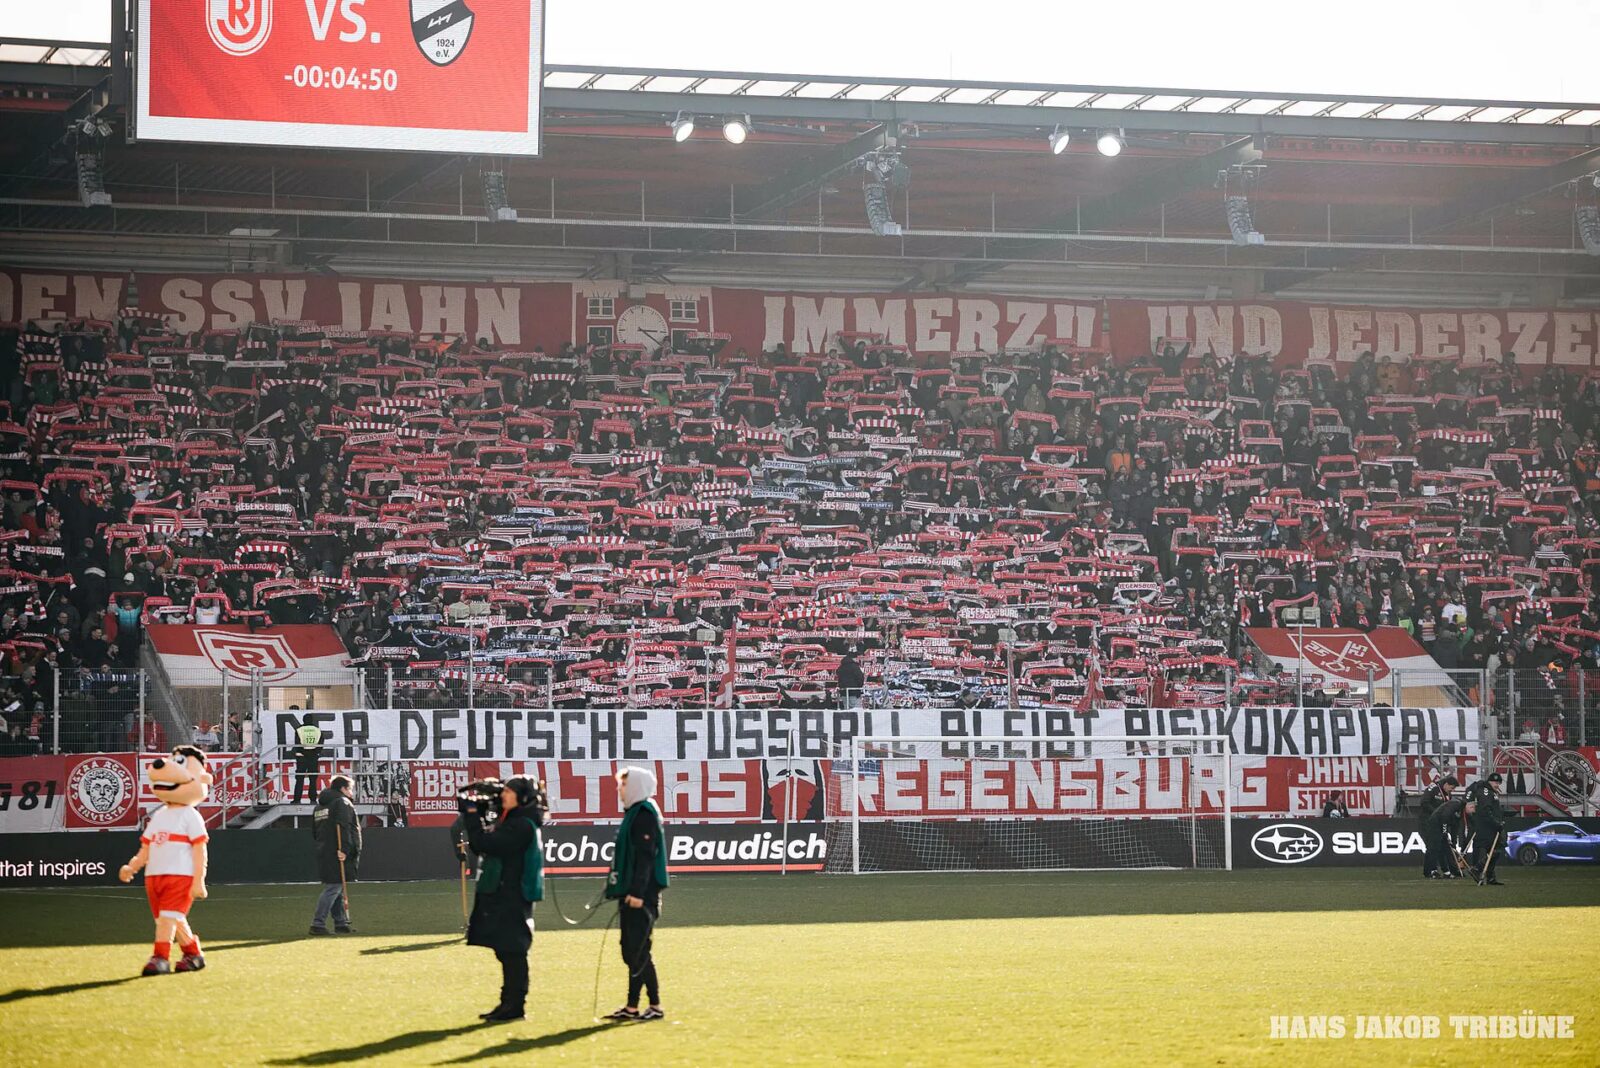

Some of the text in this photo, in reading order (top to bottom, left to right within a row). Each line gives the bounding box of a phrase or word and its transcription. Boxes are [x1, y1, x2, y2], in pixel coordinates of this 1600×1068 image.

[305, 0, 381, 43] VS.
[436, 39, 455, 48] 1924
[284, 65, 398, 91] -00:04:50
[161, 278, 306, 337] SSV
[1309, 306, 1600, 366] JEDERZE
[400, 709, 648, 760] DEUTSCHE
[676, 710, 916, 759] FUSSBALL
[941, 710, 1099, 759] BLEIBT
[1298, 757, 1368, 784] JAHN
[18, 781, 57, 812] 81
[841, 759, 1267, 812] REGENSBURG
[414, 800, 459, 810] REGENSBU
[545, 836, 616, 862] toha
[670, 832, 827, 861] Baudisch
[1331, 832, 1428, 854] SUBA
[0, 859, 106, 879] that inspires
